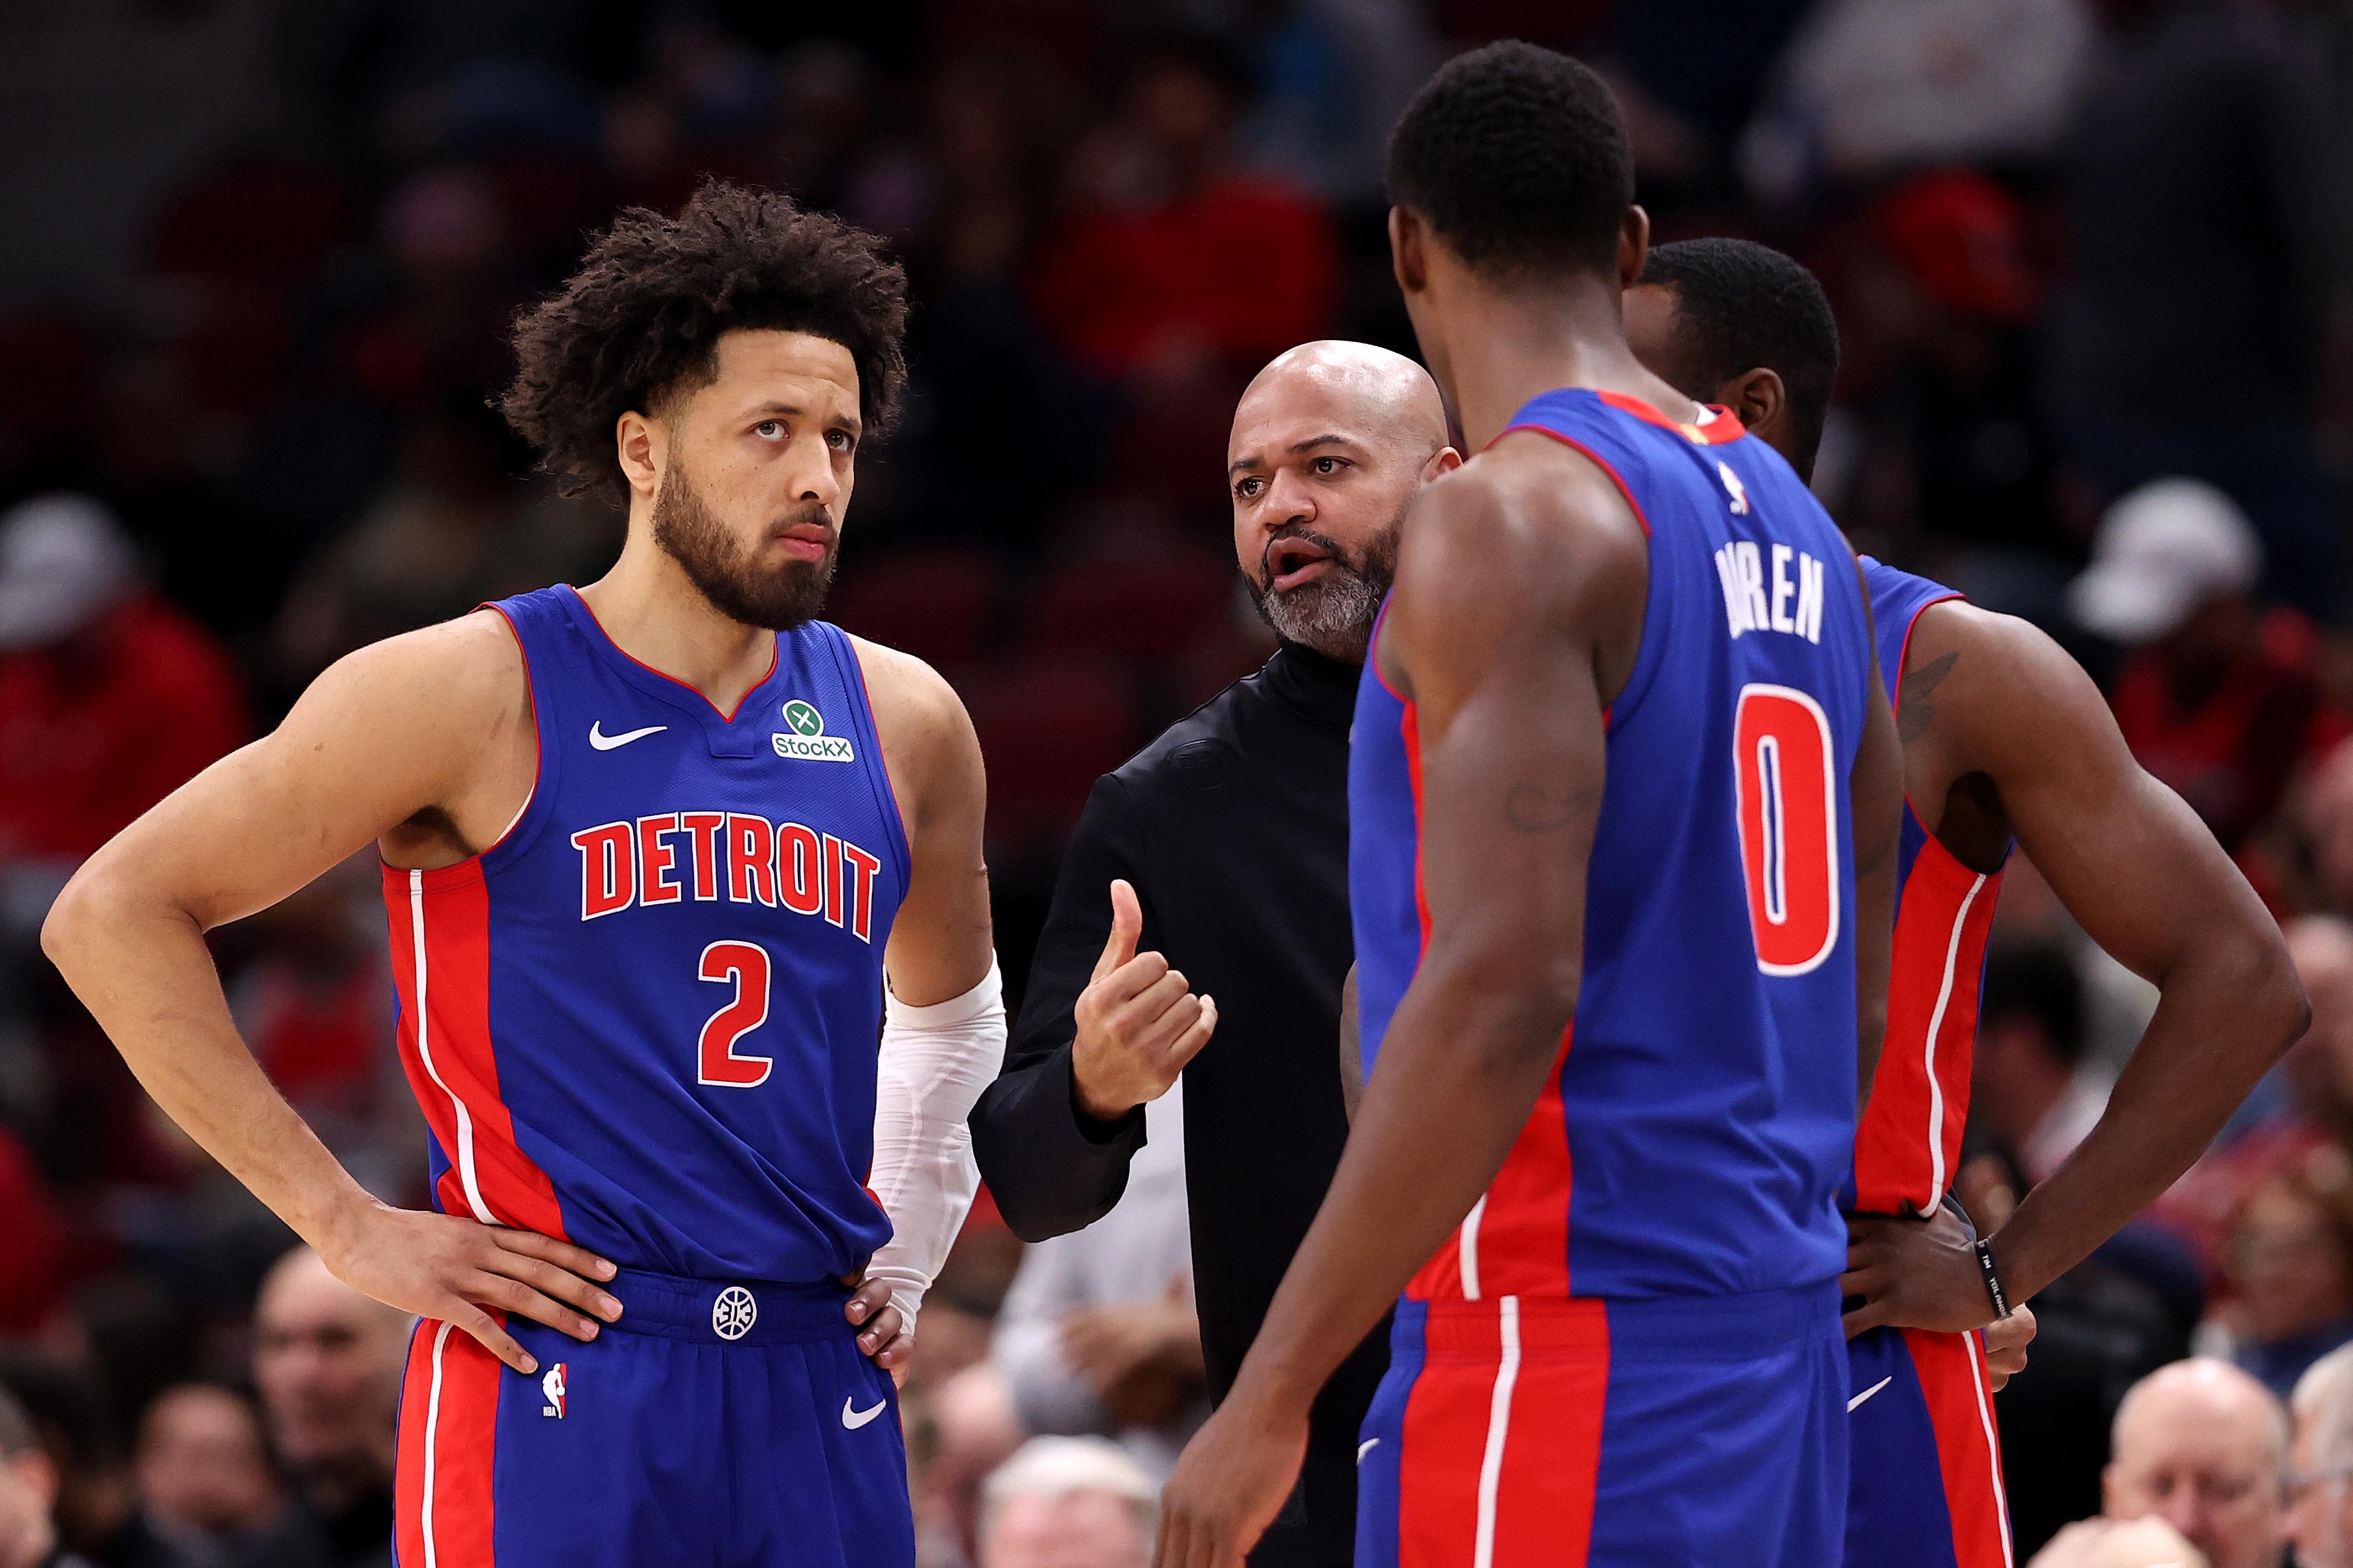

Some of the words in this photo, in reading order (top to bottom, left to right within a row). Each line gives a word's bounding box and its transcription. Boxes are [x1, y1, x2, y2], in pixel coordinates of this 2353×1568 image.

[1715, 541, 1824, 645] UREN
[775, 737, 851, 758] StockX
[570, 811, 881, 944] DETROIT
[1733, 682, 1840, 978] 0
[698, 940, 773, 1089] 2
[543, 1406, 557, 1417] NBA
